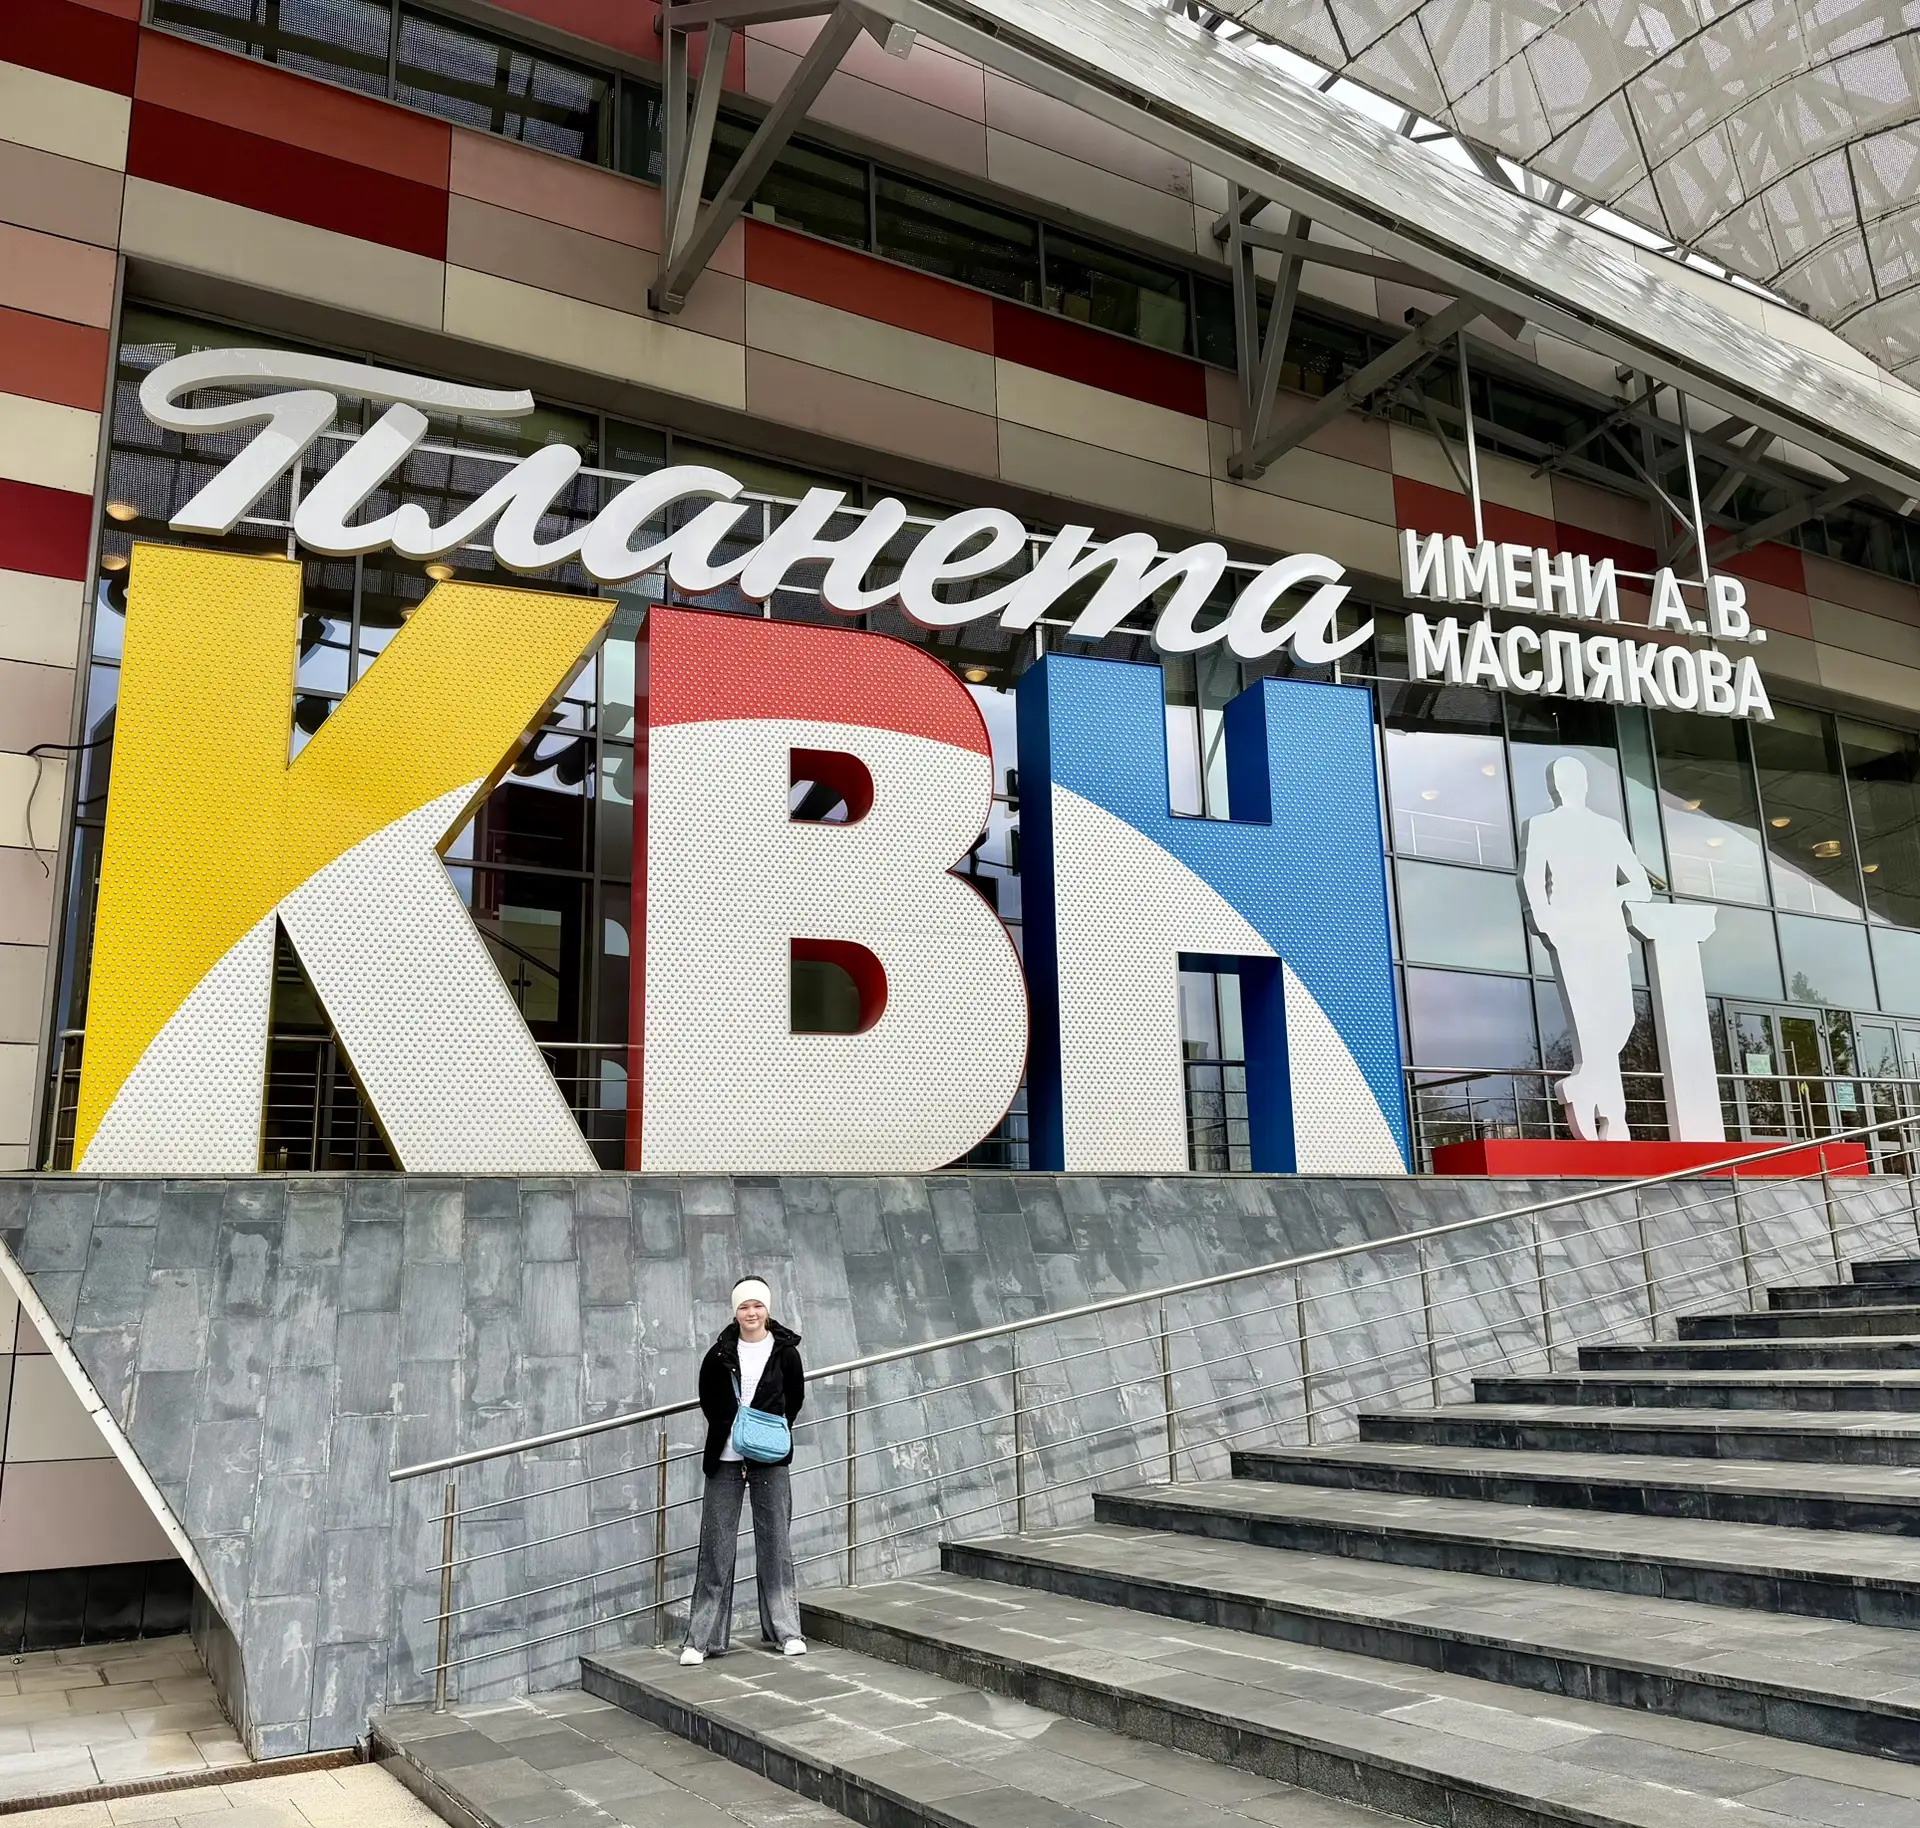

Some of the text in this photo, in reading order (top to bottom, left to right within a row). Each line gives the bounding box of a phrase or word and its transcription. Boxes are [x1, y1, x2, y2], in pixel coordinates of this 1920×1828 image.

[139, 347, 1374, 664] Планета
[1400, 529, 1619, 625] ИМЕНИ
[1404, 613, 1775, 723] МАСЛЯКОВА
[73, 540, 1411, 1174] КВН
